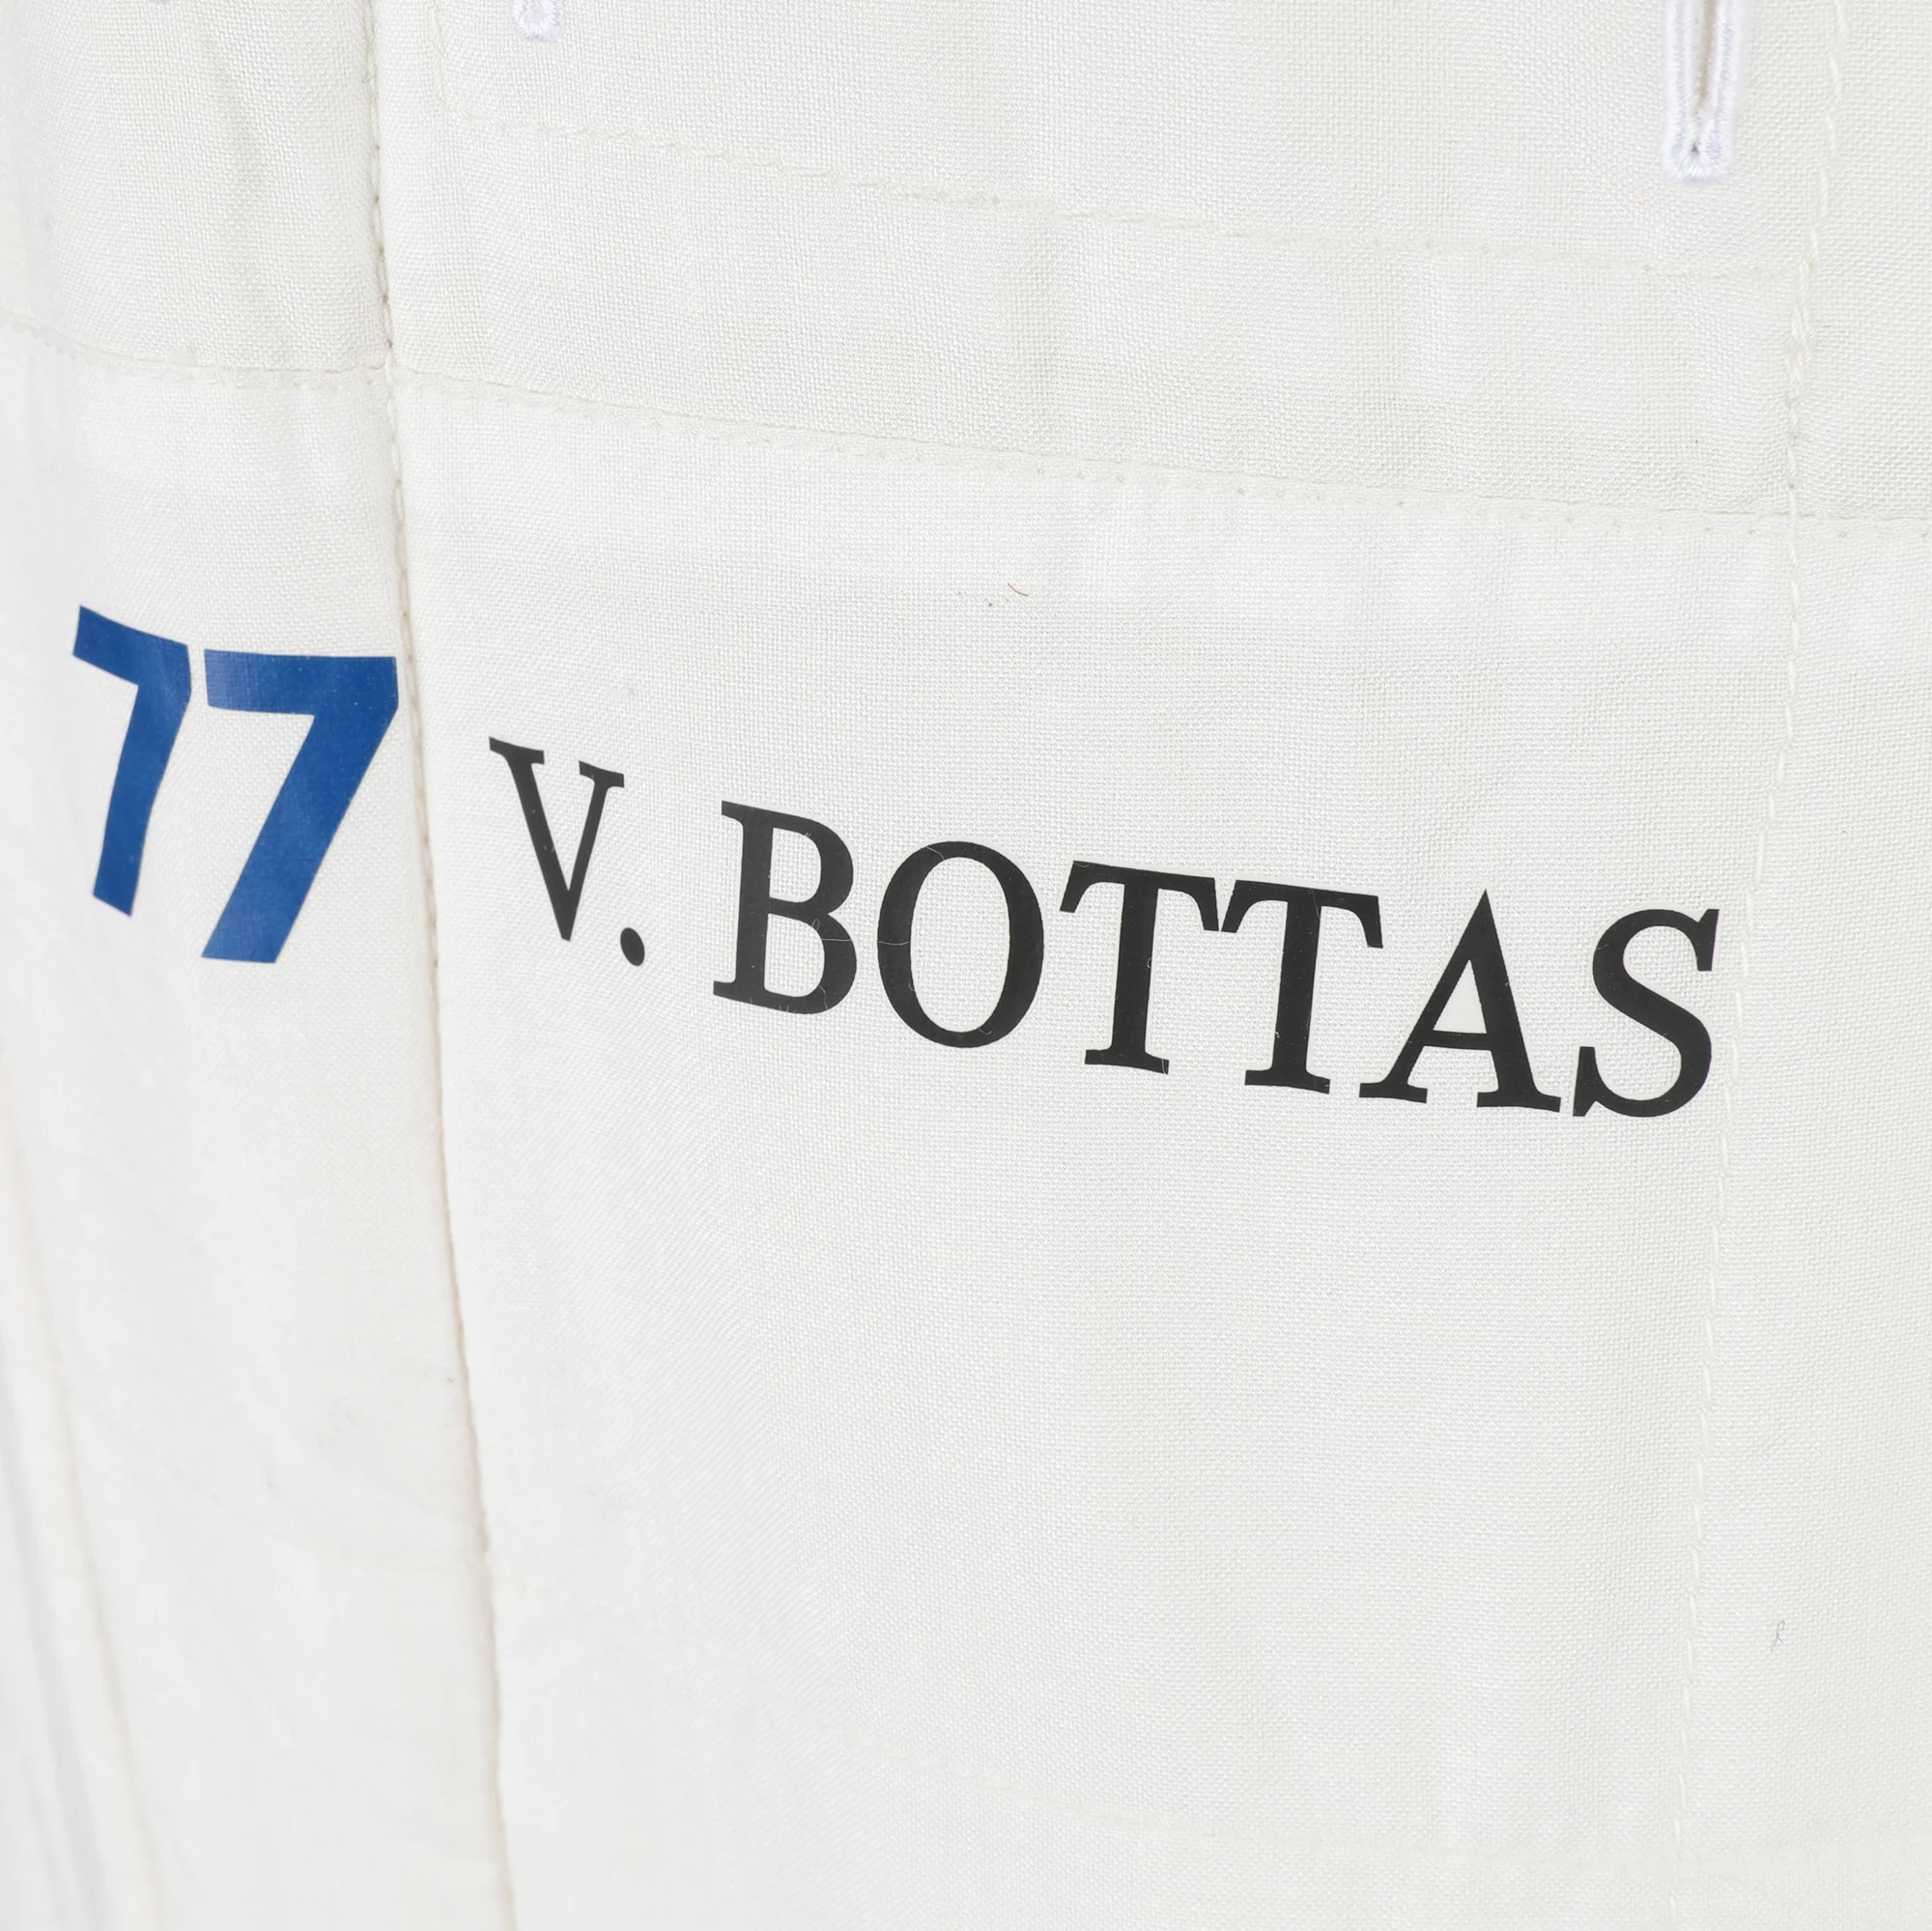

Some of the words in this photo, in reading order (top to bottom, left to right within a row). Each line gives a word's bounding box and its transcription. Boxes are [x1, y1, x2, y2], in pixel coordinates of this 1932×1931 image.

[73, 607, 398, 963] 77
[490, 738, 644, 966] V.
[714, 801, 1719, 1117] BOTTAS
